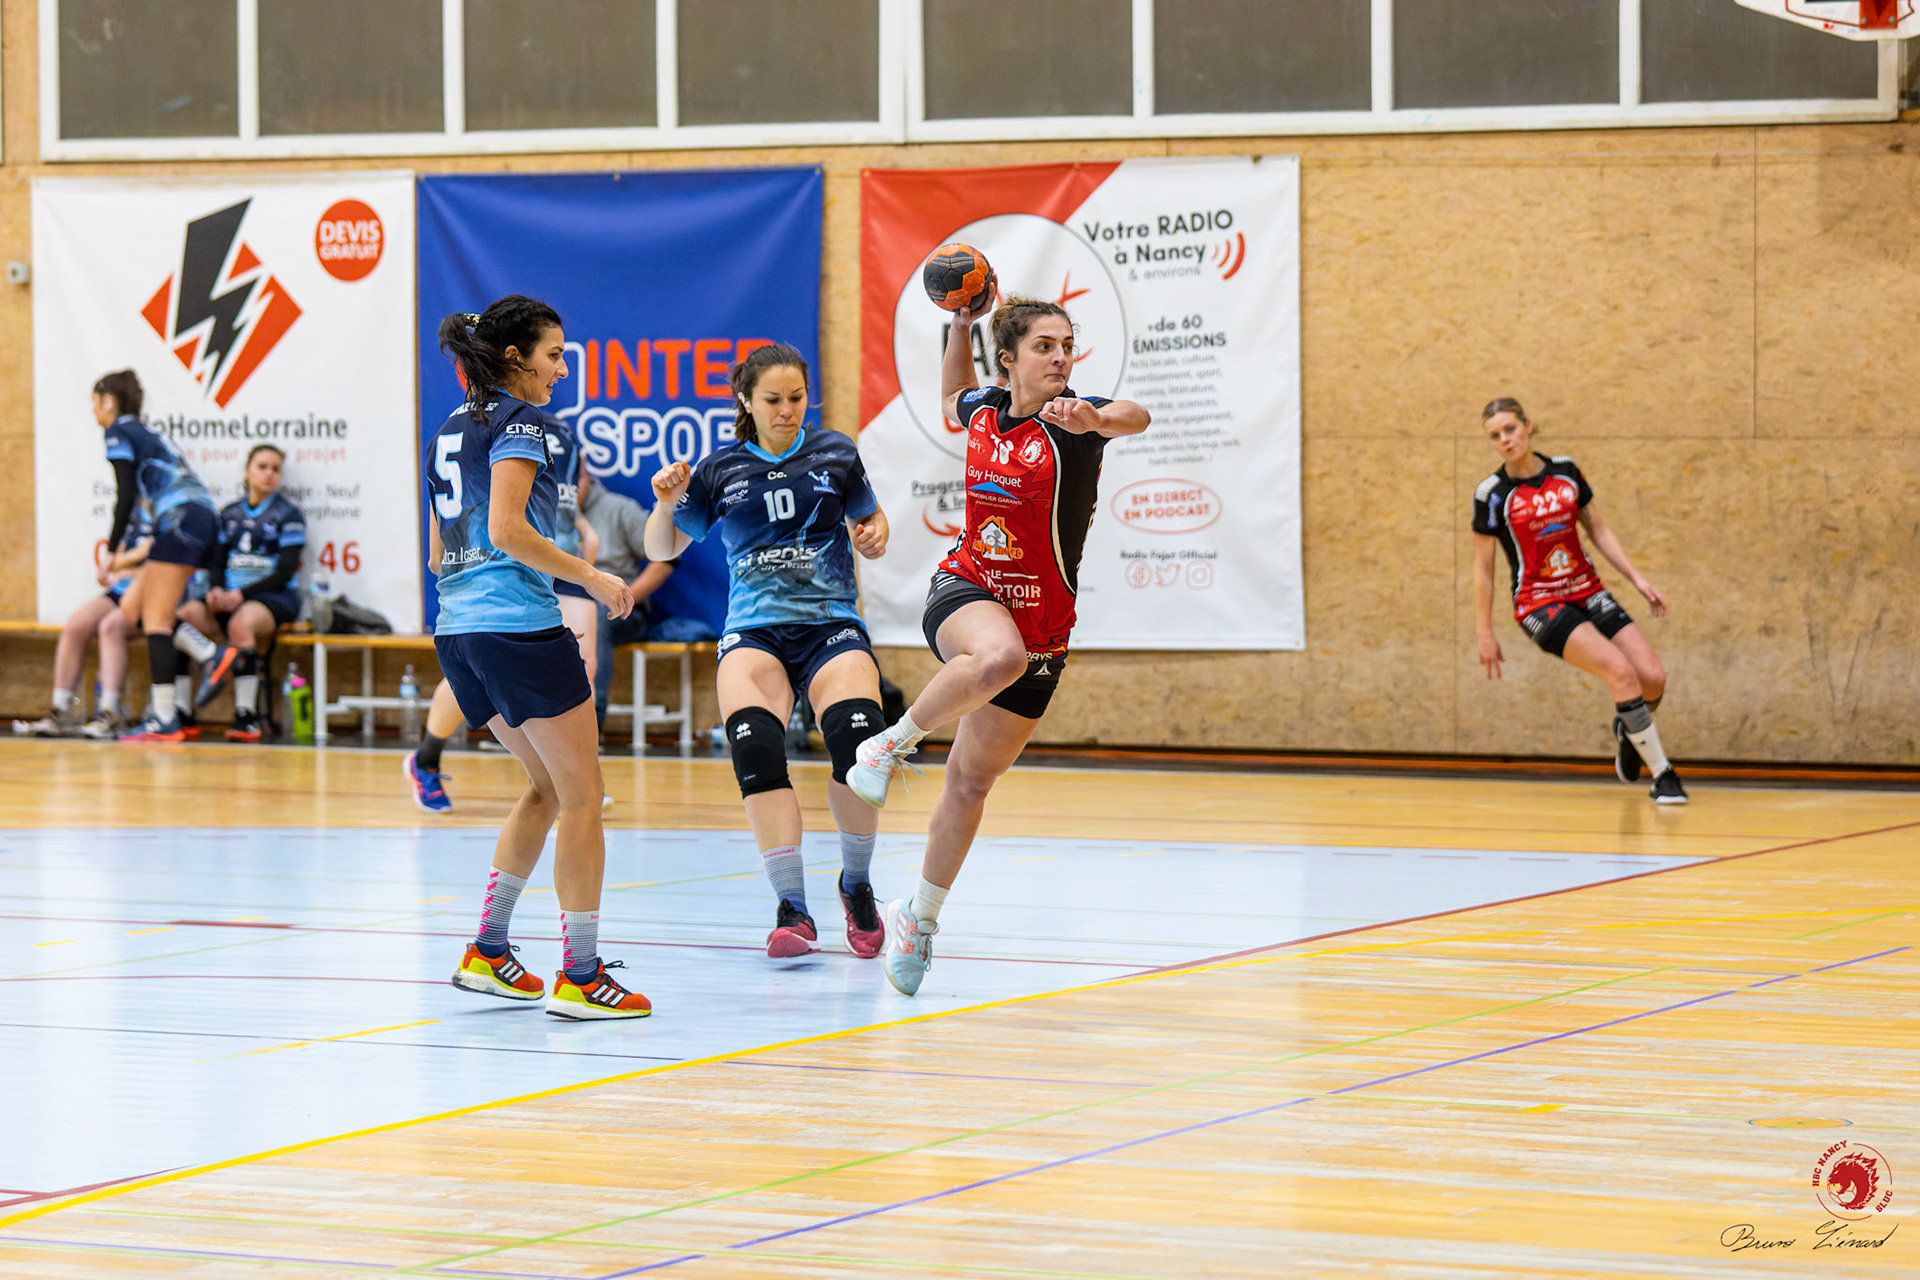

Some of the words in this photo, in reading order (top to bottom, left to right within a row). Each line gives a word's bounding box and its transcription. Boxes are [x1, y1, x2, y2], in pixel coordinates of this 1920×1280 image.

[320, 219, 381, 243] DEVIS
[1083, 222, 1149, 242] Votre
[1158, 209, 1233, 236] RADIO
[319, 243, 379, 260] GRATUIT
[1115, 245, 1128, 265] à
[1136, 244, 1206, 263] Nancy
[1128, 269, 1139, 281] &
[1143, 265, 1201, 280] environs
[1182, 314, 1203, 329] 60
[1133, 332, 1227, 354] ÉMISSIONS
[202, 449, 238, 462] pour
[296, 446, 347, 464] projet
[434, 431, 464, 520] 5
[967, 465, 983, 481] Guy
[984, 469, 1022, 488] Hoquet
[763, 487, 796, 523] 10
[1153, 488, 1203, 503] DIRECT
[1532, 490, 1563, 517] 22
[1145, 503, 1210, 518] PODCAST
[319, 541, 361, 573] 46
